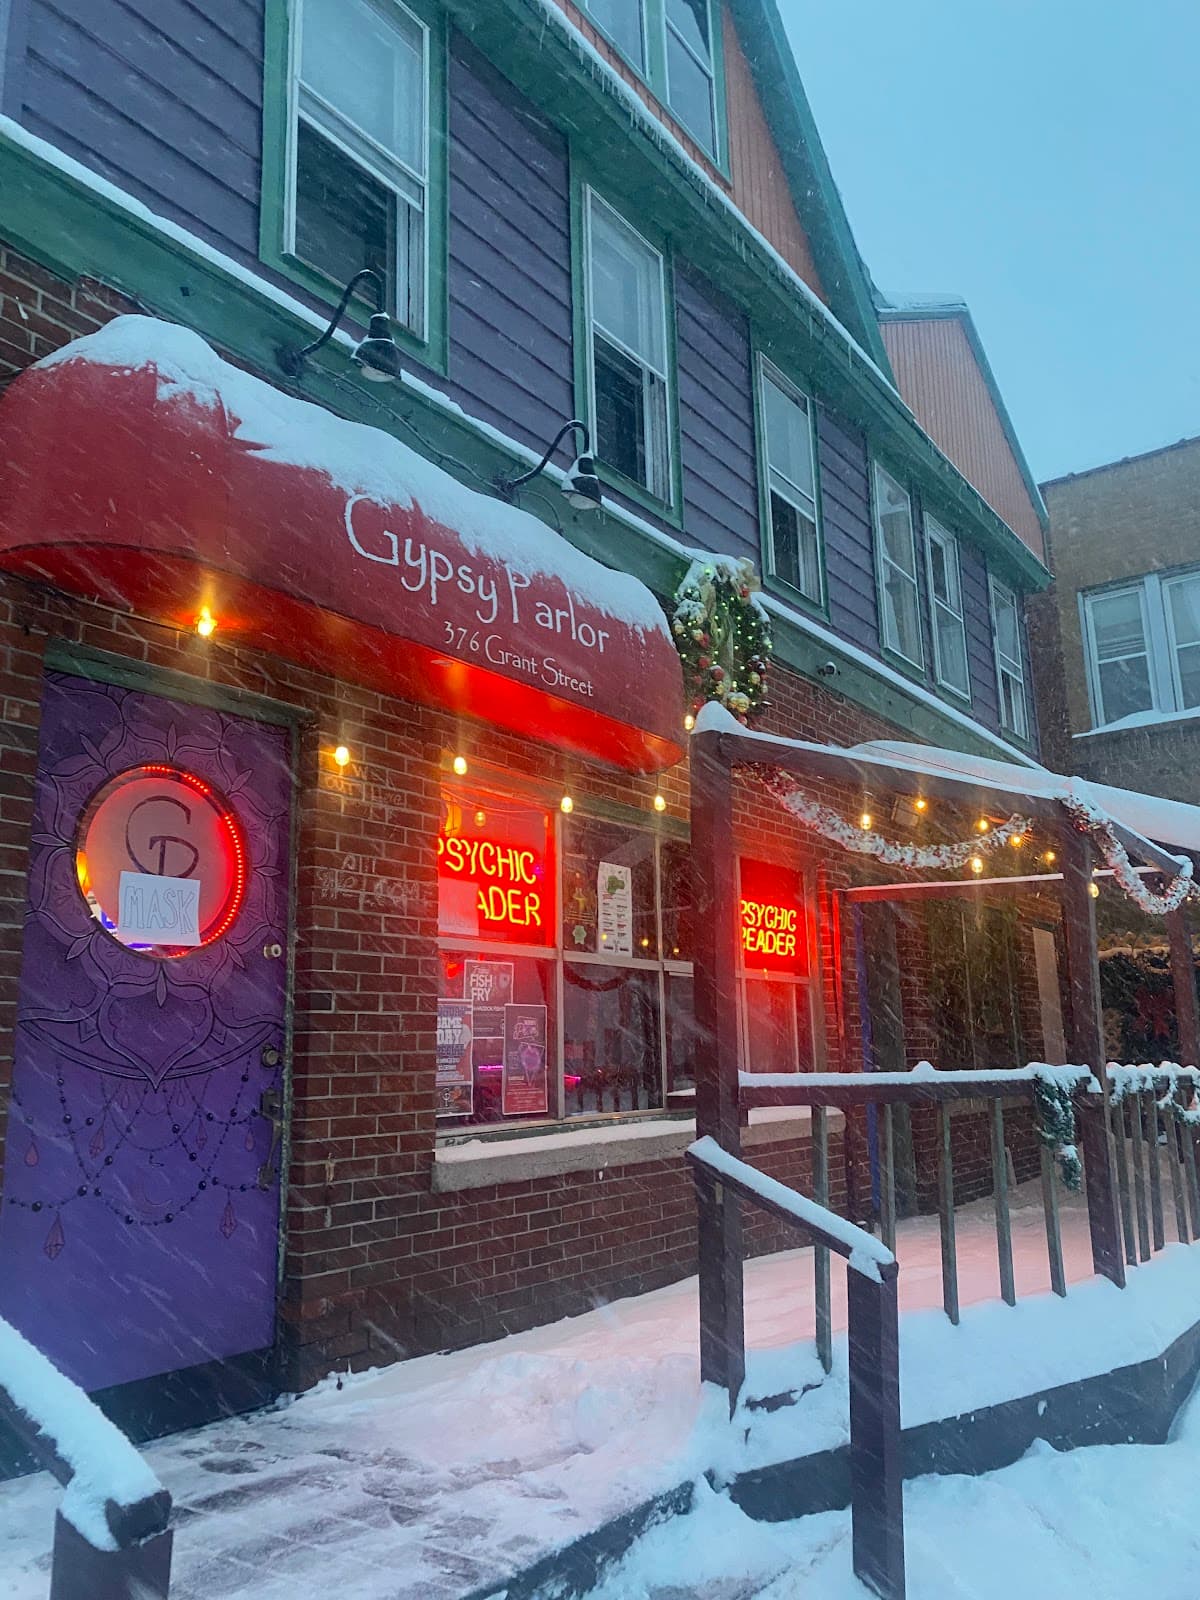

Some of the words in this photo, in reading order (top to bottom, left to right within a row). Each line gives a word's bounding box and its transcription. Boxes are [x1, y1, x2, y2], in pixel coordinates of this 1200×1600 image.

[343, 494, 498, 624] Gypsy
[505, 562, 610, 653] Parlor
[443, 620, 481, 651] 376
[485, 634, 538, 675] Grant
[541, 657, 594, 697] Street
[121, 885, 195, 935] MASK
[477, 885, 542, 926] ADER
[470, 973, 493, 989] FISH
[471, 988, 491, 1002] FRY
